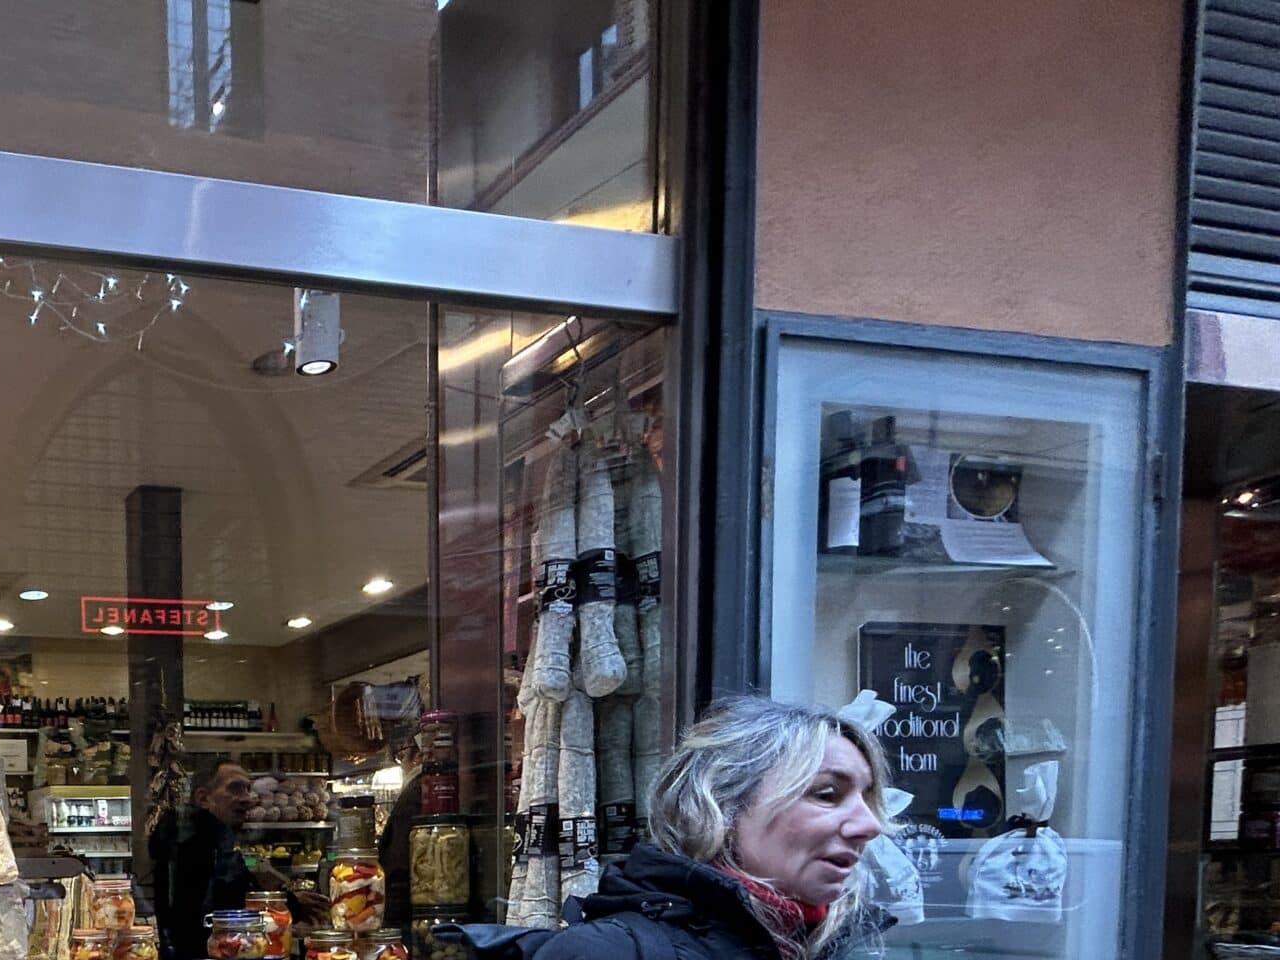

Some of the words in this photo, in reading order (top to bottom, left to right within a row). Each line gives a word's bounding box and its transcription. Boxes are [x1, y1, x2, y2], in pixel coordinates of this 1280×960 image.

[904, 642, 931, 669] the
[893, 677, 941, 712] finest
[900, 745, 937, 772] ham
